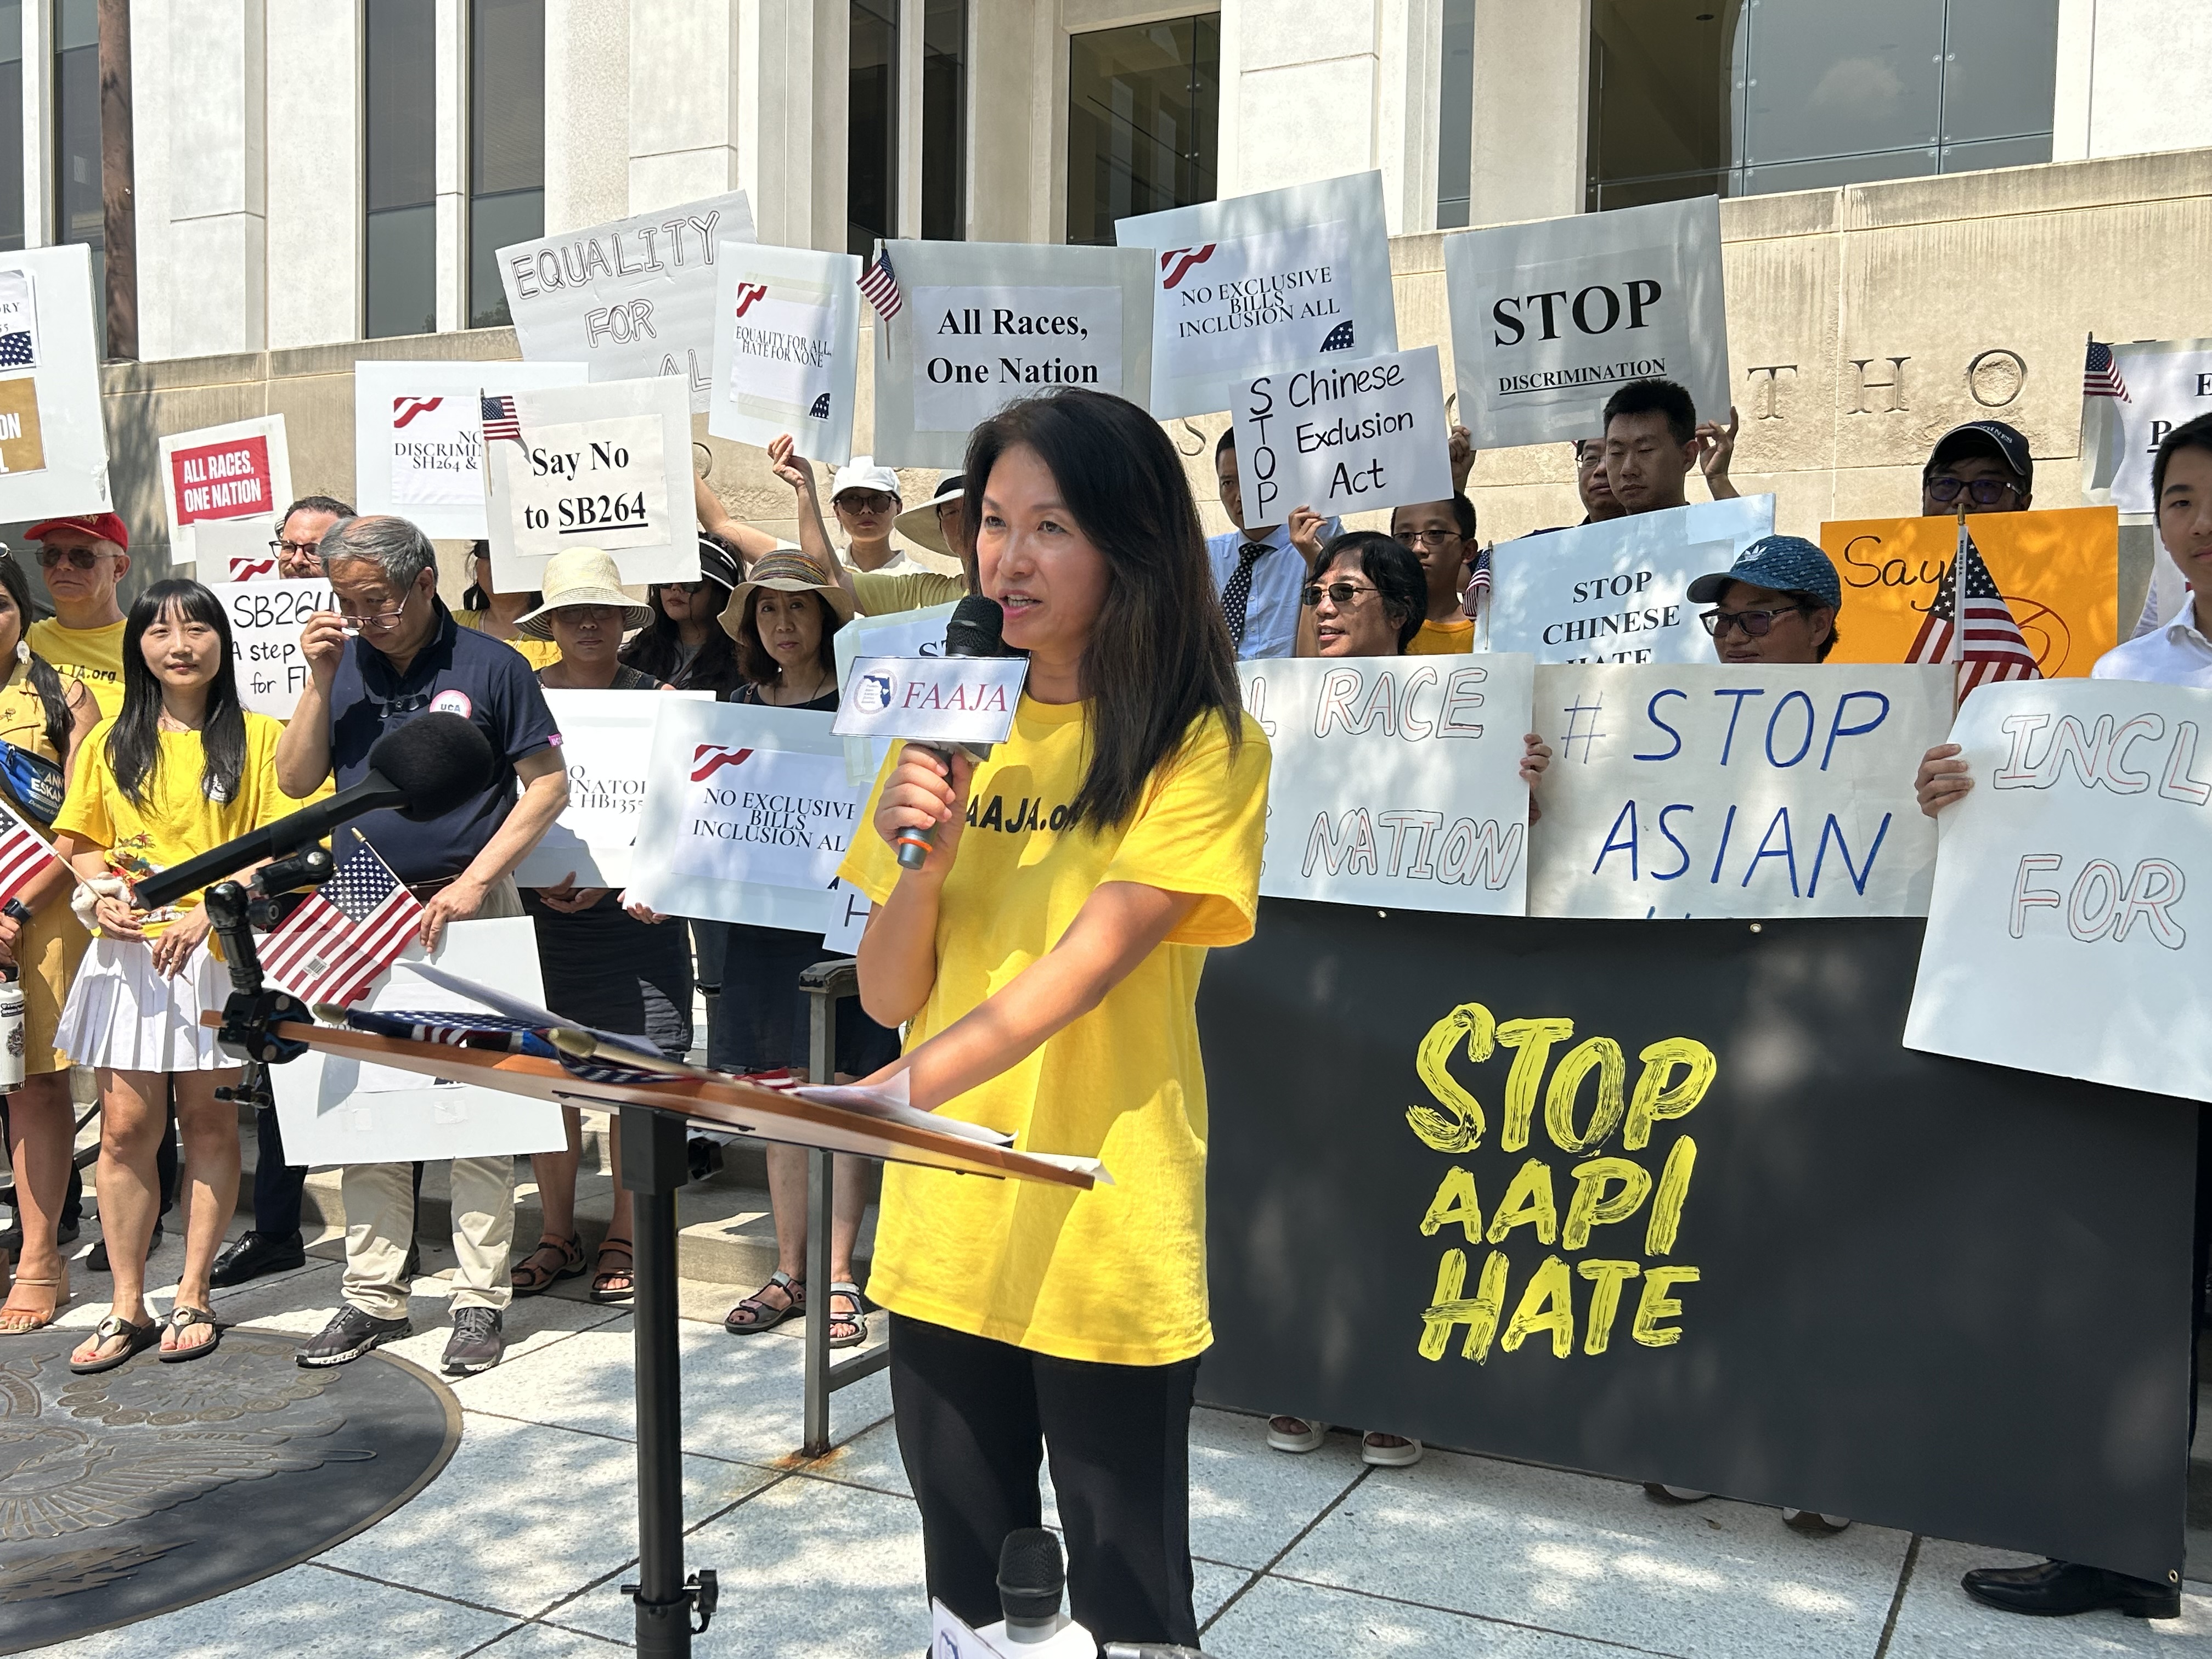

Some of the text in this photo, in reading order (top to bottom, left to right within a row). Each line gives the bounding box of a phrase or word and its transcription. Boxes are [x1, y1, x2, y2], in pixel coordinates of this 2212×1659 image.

[510, 211, 720, 300] EQUALITY
[1181, 267, 1332, 307] NO EXCLUSIVE
[1229, 291, 1284, 314] BILLS
[0, 302, 20, 313] RY
[584, 298, 657, 348] FOR
[937, 308, 1088, 340] All Races,
[1179, 298, 1340, 338] INCLUSION ALL
[1493, 279, 1662, 347] STOP
[736, 326, 785, 348] EQUALITY
[787, 335, 808, 352] FOR
[742, 340, 823, 368] HATE FOR NONE
[927, 357, 1099, 383] One Nation
[1289, 364, 1405, 408] Chinese
[1499, 358, 1666, 392] DISCRIMINATION
[1249, 377, 1278, 520] STOP
[1296, 412, 1414, 454] Exclusion
[184, 450, 254, 484] ALL RACES,
[413, 456, 478, 472] SH264 &
[532, 441, 629, 481] Say No
[1329, 459, 1387, 499] Act
[184, 478, 262, 513] ONE NATION
[524, 492, 646, 529] to SB264
[1573, 571, 1652, 603] STOP
[1844, 535, 1945, 612] Say
[1543, 605, 1680, 645] CHINESE
[250, 642, 296, 664] step
[250, 672, 276, 694] for
[901, 682, 1008, 712] FAAJA
[441, 704, 460, 712] UCA
[1314, 666, 1488, 742] RACE
[1994, 713, 2211, 805] INCL
[703, 788, 737, 806] NO
[692, 820, 814, 848] INCLUSION
[750, 809, 806, 831] BILLS
[1301, 808, 1524, 891] NATION
[1592, 800, 1893, 899] ASIAN
[2008, 854, 2186, 950] FOR
[1406, 1002, 1717, 1158] STOP
[1420, 1134, 1698, 1256] AAPI
[1418, 1248, 1701, 1365] HATE
